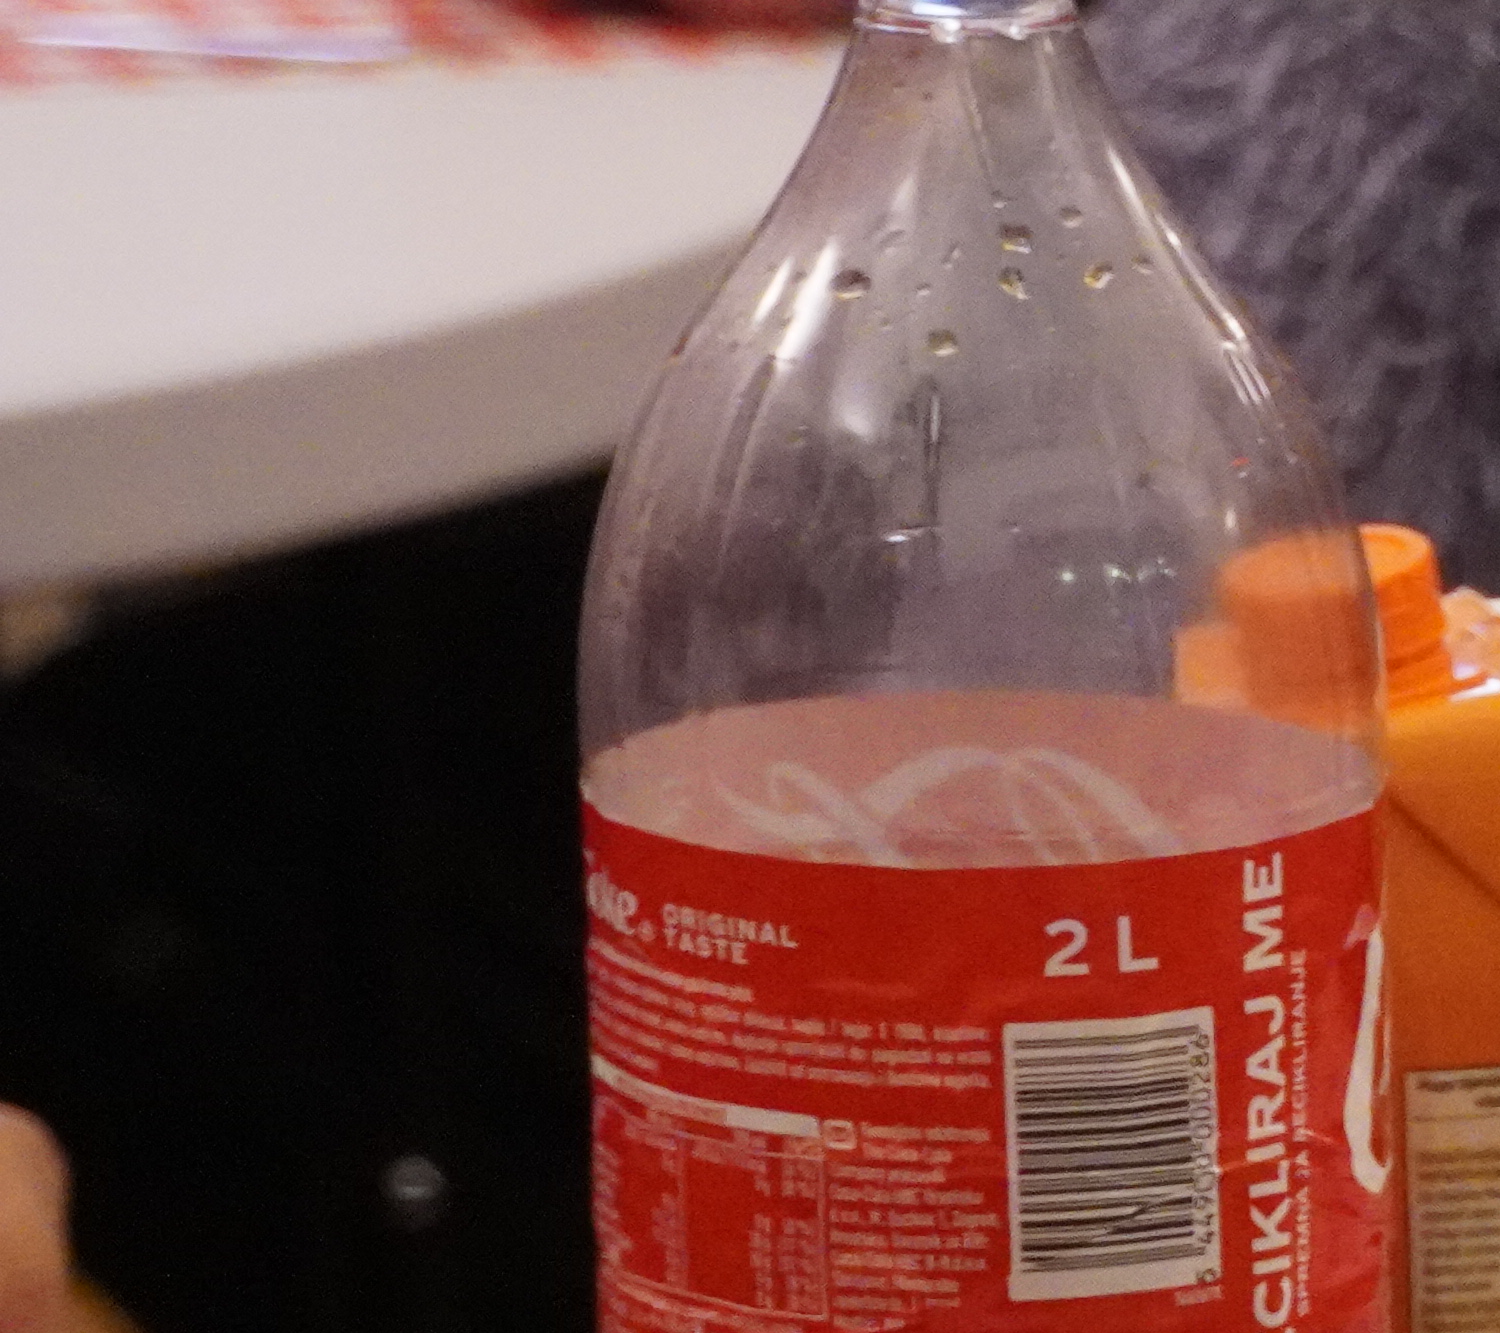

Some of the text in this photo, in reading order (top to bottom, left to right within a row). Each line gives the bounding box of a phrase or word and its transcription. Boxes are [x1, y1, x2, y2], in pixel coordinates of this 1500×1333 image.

[662, 903, 799, 949] ORIGINAL
[1242, 851, 1285, 974] ME
[663, 926, 749, 965] TASTE
[1043, 914, 1160, 978] 2 L
[1290, 947, 1310, 1144] RECIKLIRANJE
